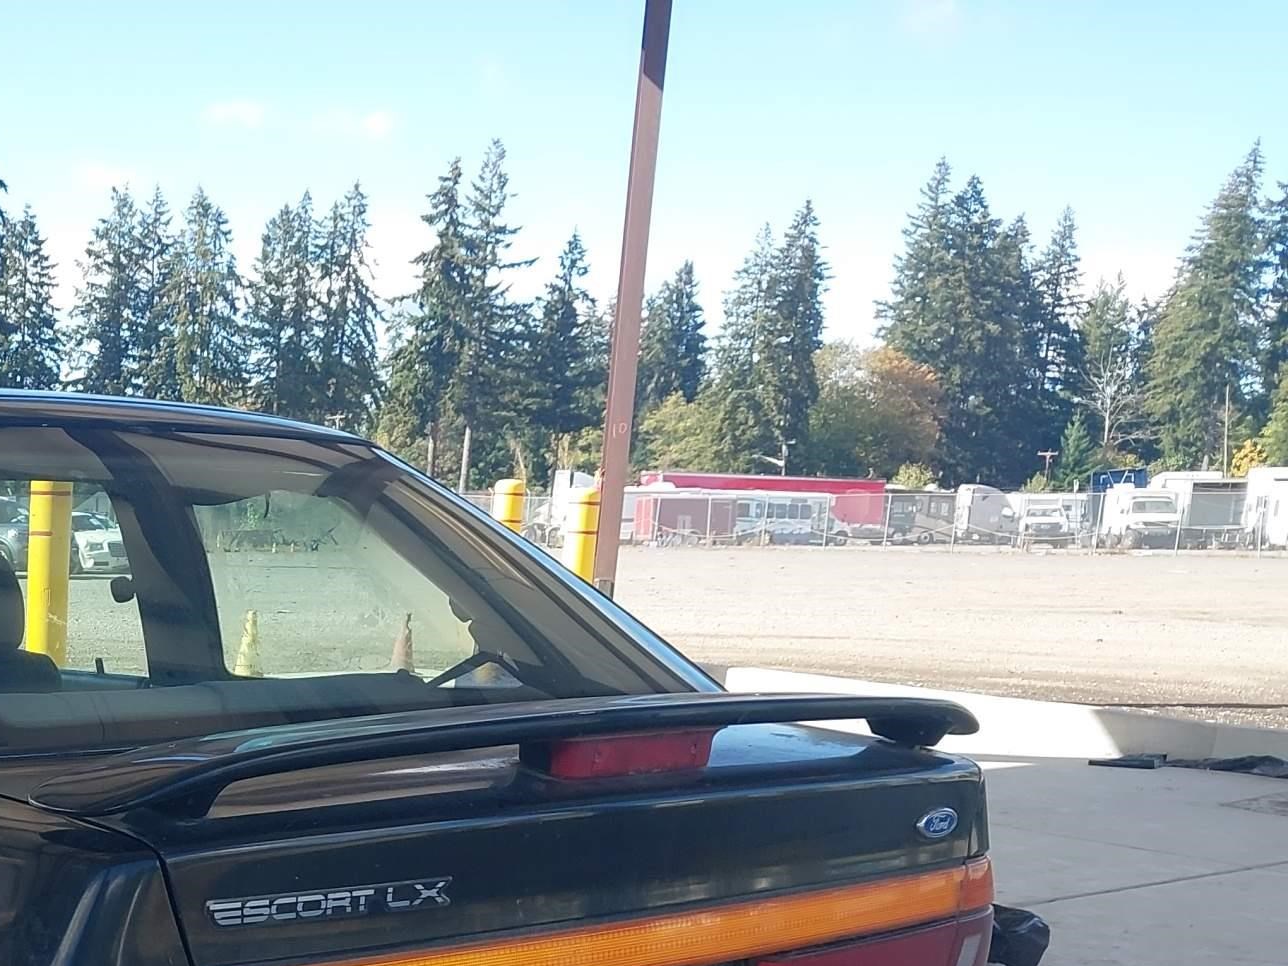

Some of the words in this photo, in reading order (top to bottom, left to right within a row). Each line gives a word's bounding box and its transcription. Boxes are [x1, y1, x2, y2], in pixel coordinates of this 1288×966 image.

[929, 814, 951, 832] Ford
[209, 889, 375, 926] ESCORT
[386, 880, 448, 909] LX
